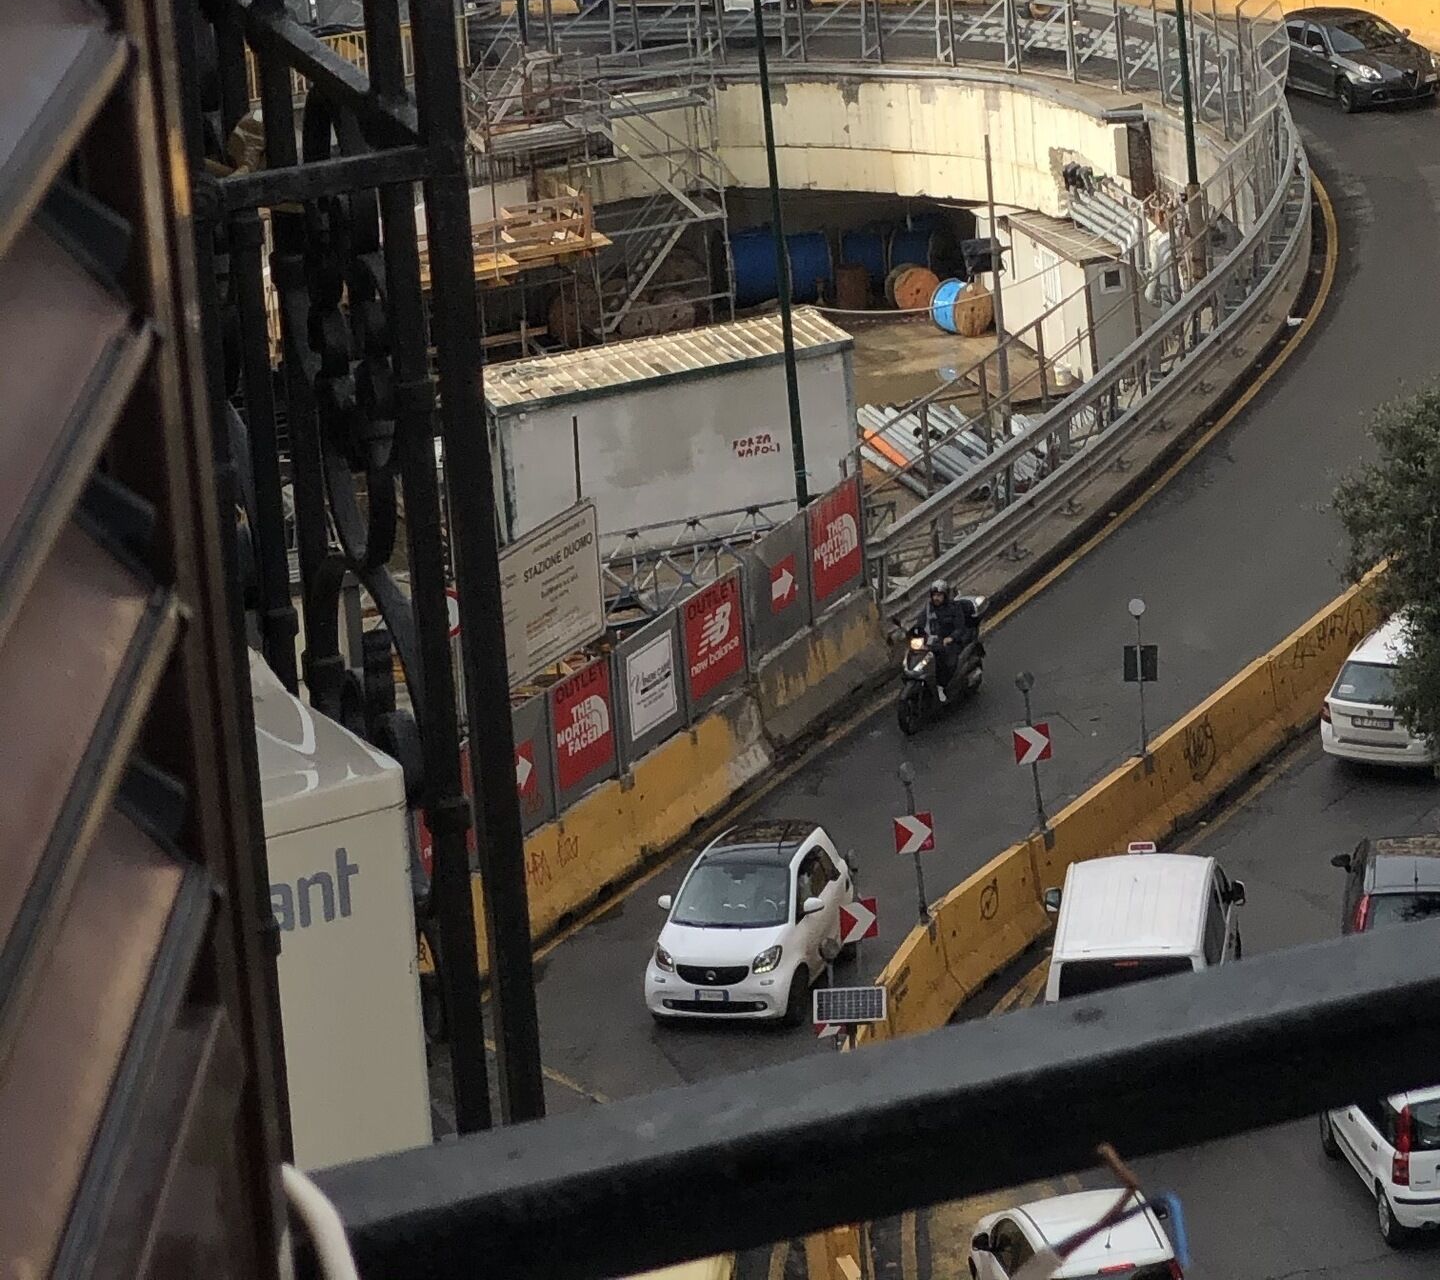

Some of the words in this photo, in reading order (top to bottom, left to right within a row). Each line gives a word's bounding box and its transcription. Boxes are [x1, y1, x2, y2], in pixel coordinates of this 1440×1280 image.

[732, 433, 771, 450] FORZA
[737, 442, 781, 458] NAPOLI
[826, 518, 844, 539] THE
[523, 550, 563, 583] STAZIONE
[563, 532, 594, 561] DUOMO
[813, 531, 849, 562] NORTH
[823, 546, 847, 571] FACE
[687, 577, 737, 620] OUTLET
[691, 657, 709, 677] new
[709, 635, 740, 665] balance
[555, 661, 608, 704] OUTLET
[571, 699, 592, 723] THE
[556, 717, 595, 748] NORTH
[568, 729, 596, 757] FACE
